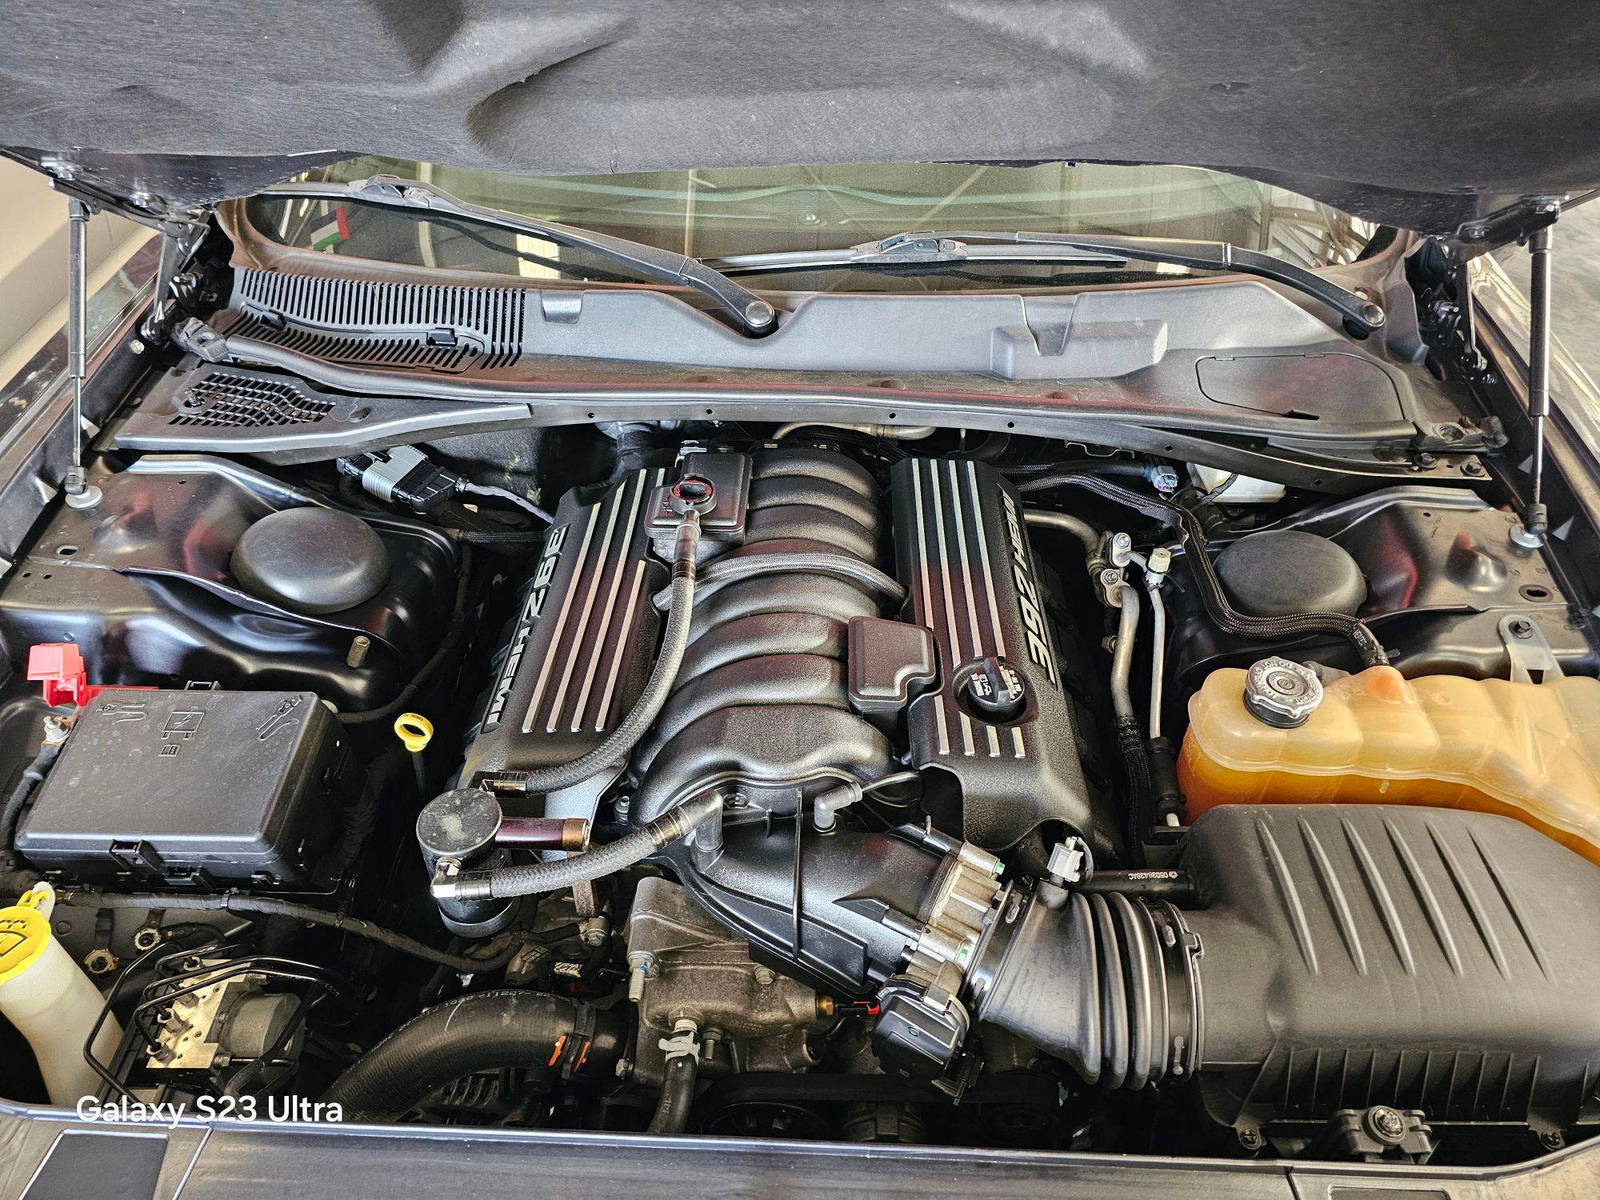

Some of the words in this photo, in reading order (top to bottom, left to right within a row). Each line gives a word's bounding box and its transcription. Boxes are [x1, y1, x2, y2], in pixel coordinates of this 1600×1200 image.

[523, 525, 567, 622] 392
[1002, 492, 1028, 571] HEMI
[1013, 565, 1057, 685] 392
[487, 626, 530, 725] HEMI
